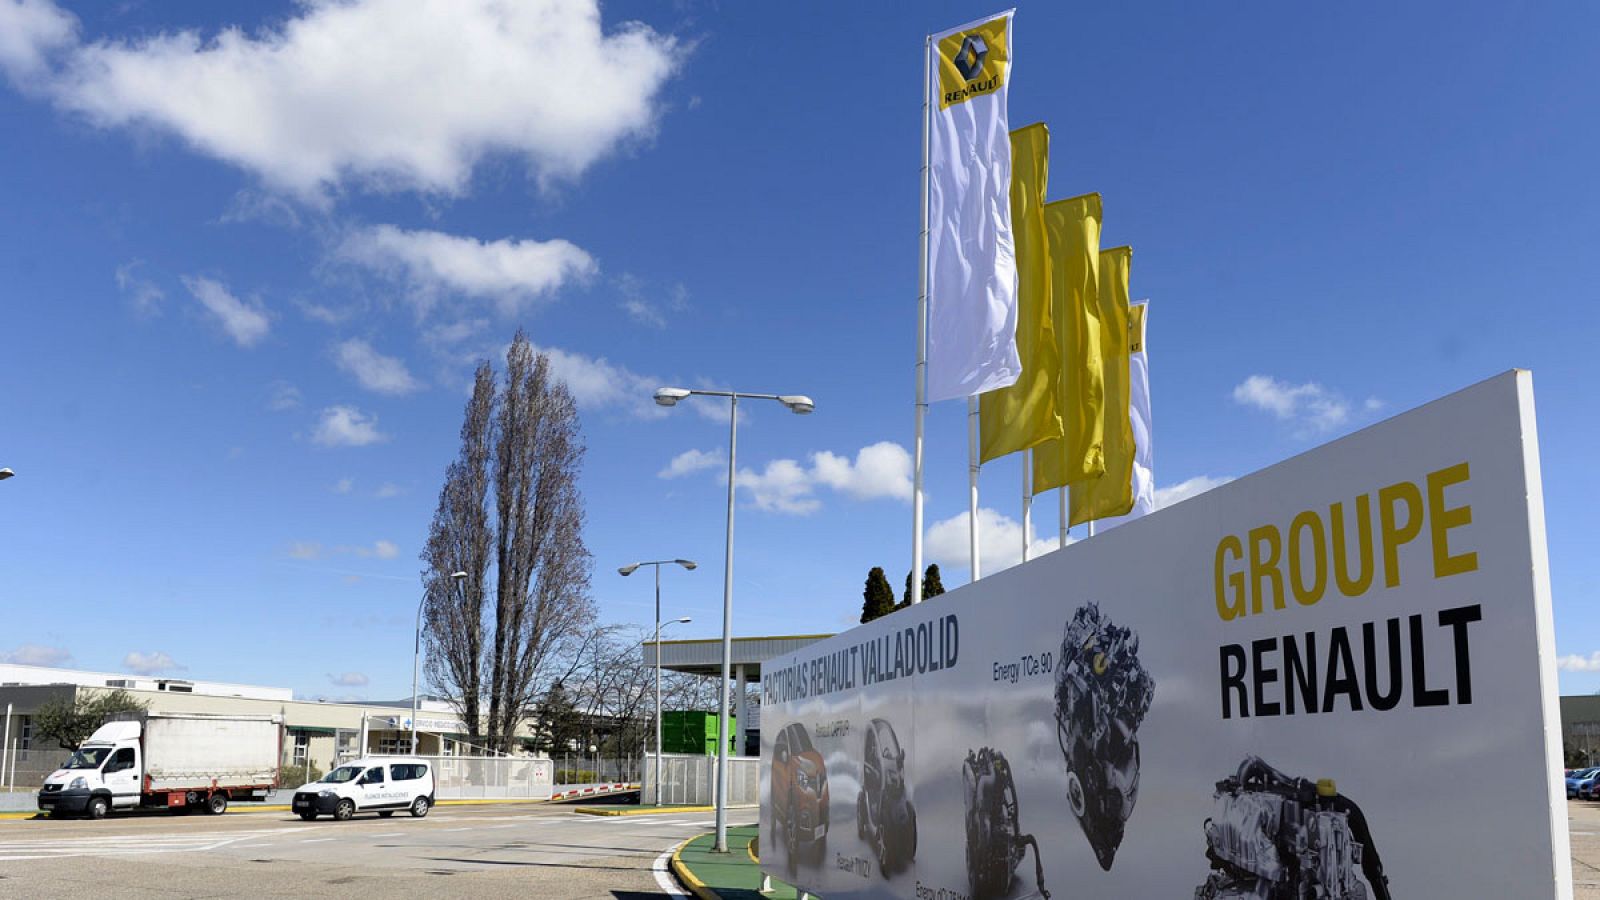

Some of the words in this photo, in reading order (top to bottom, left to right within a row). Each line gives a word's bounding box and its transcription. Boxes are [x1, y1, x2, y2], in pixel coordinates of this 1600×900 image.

[944, 74, 998, 104] RENAULT
[1214, 462, 1479, 622] GROUPE
[763, 657, 808, 706] FACTORÍAS
[810, 645, 858, 697] RENAULT
[860, 614, 960, 685] VALLADOLID
[993, 662, 1021, 684] Energy
[1021, 655, 1040, 677] TCe
[1040, 652, 1053, 674] 90
[1219, 603, 1482, 719] RENAULT
